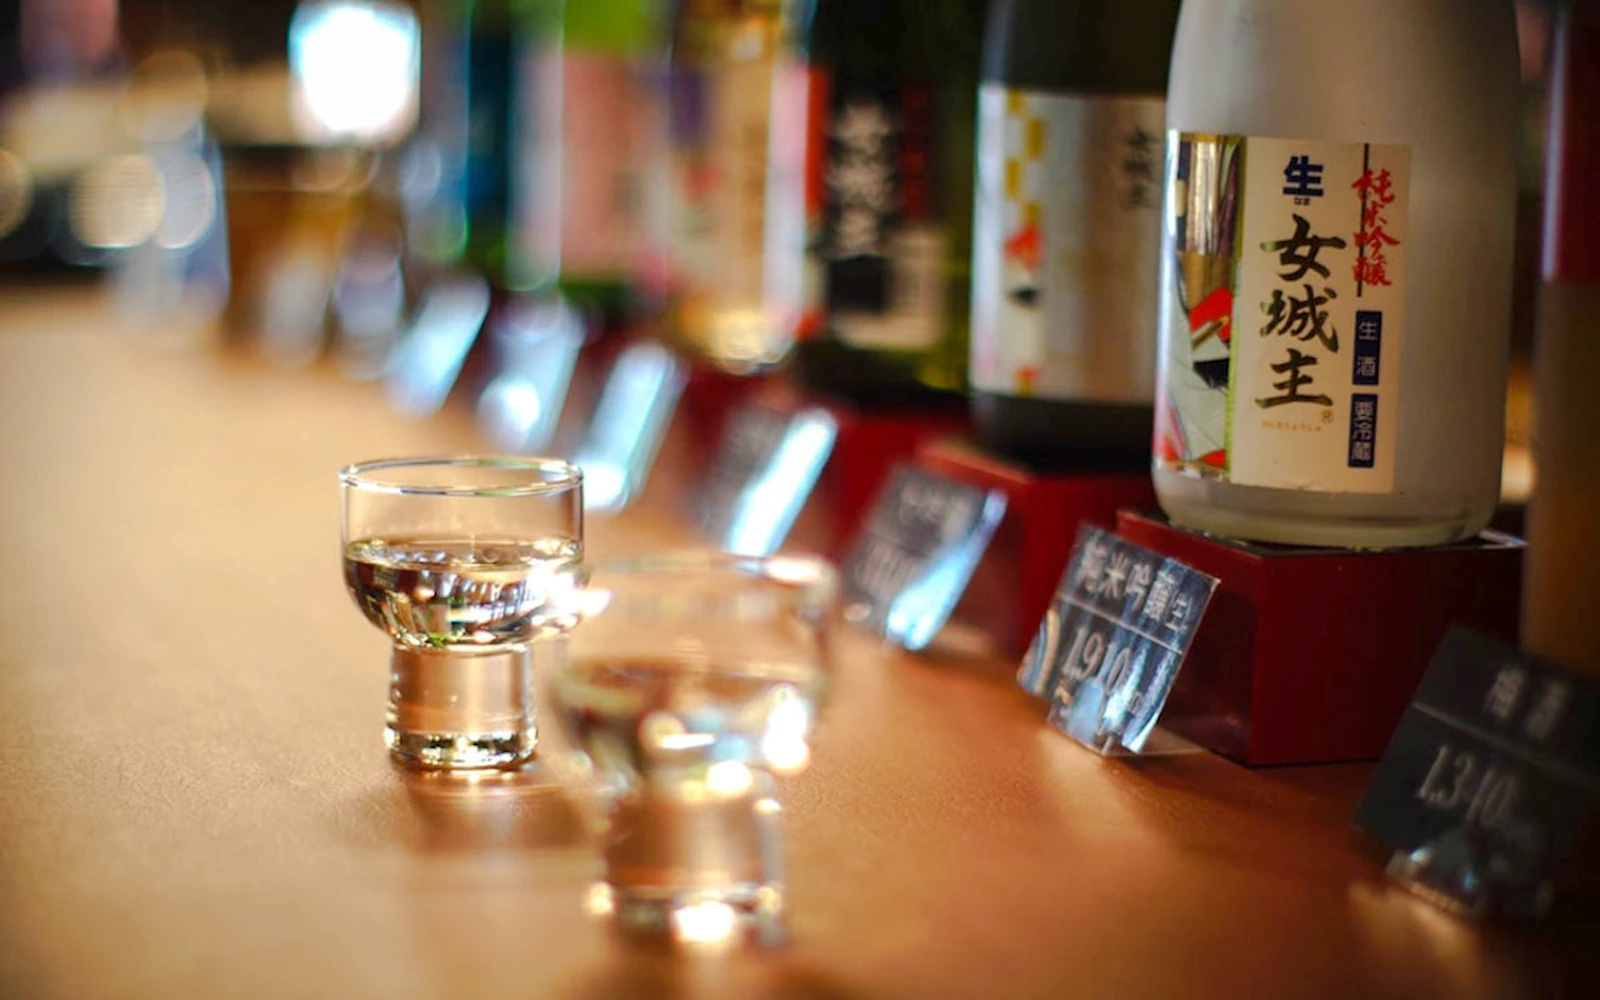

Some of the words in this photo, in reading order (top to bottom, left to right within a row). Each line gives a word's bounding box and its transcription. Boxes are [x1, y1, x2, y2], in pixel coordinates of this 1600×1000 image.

[1283, 156, 1324, 197] 生
[1254, 213, 1347, 409] 女城主
[1355, 321, 1379, 379] 生酒
[1350, 400, 1376, 463] 要冷蔵
